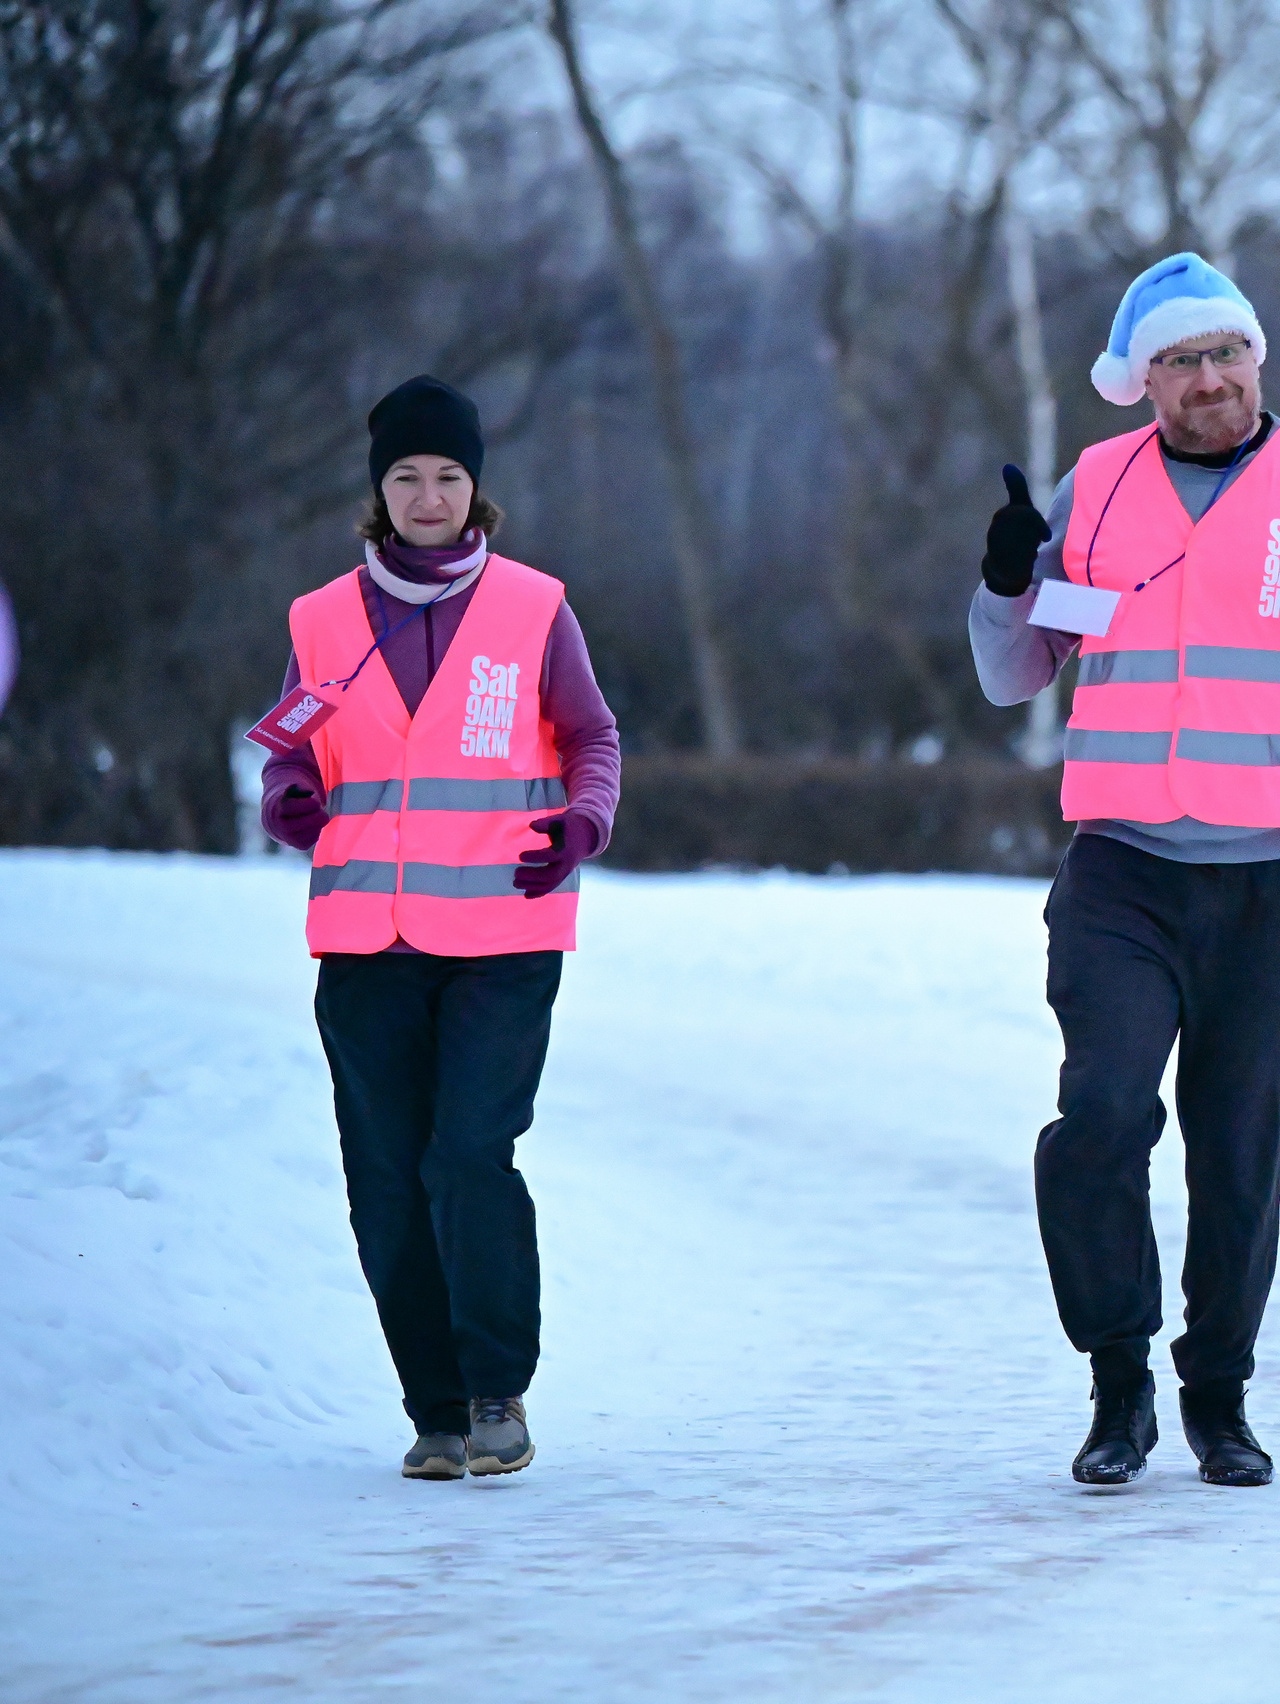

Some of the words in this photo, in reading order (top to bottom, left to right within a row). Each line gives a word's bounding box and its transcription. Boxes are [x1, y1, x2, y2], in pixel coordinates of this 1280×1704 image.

[469, 655, 520, 699] Sat
[288, 706, 313, 725] 9AM
[297, 694, 324, 716] Sat
[465, 694, 517, 730] 9AM
[276, 716, 303, 734] 5KM
[460, 725, 512, 760] 5KM
